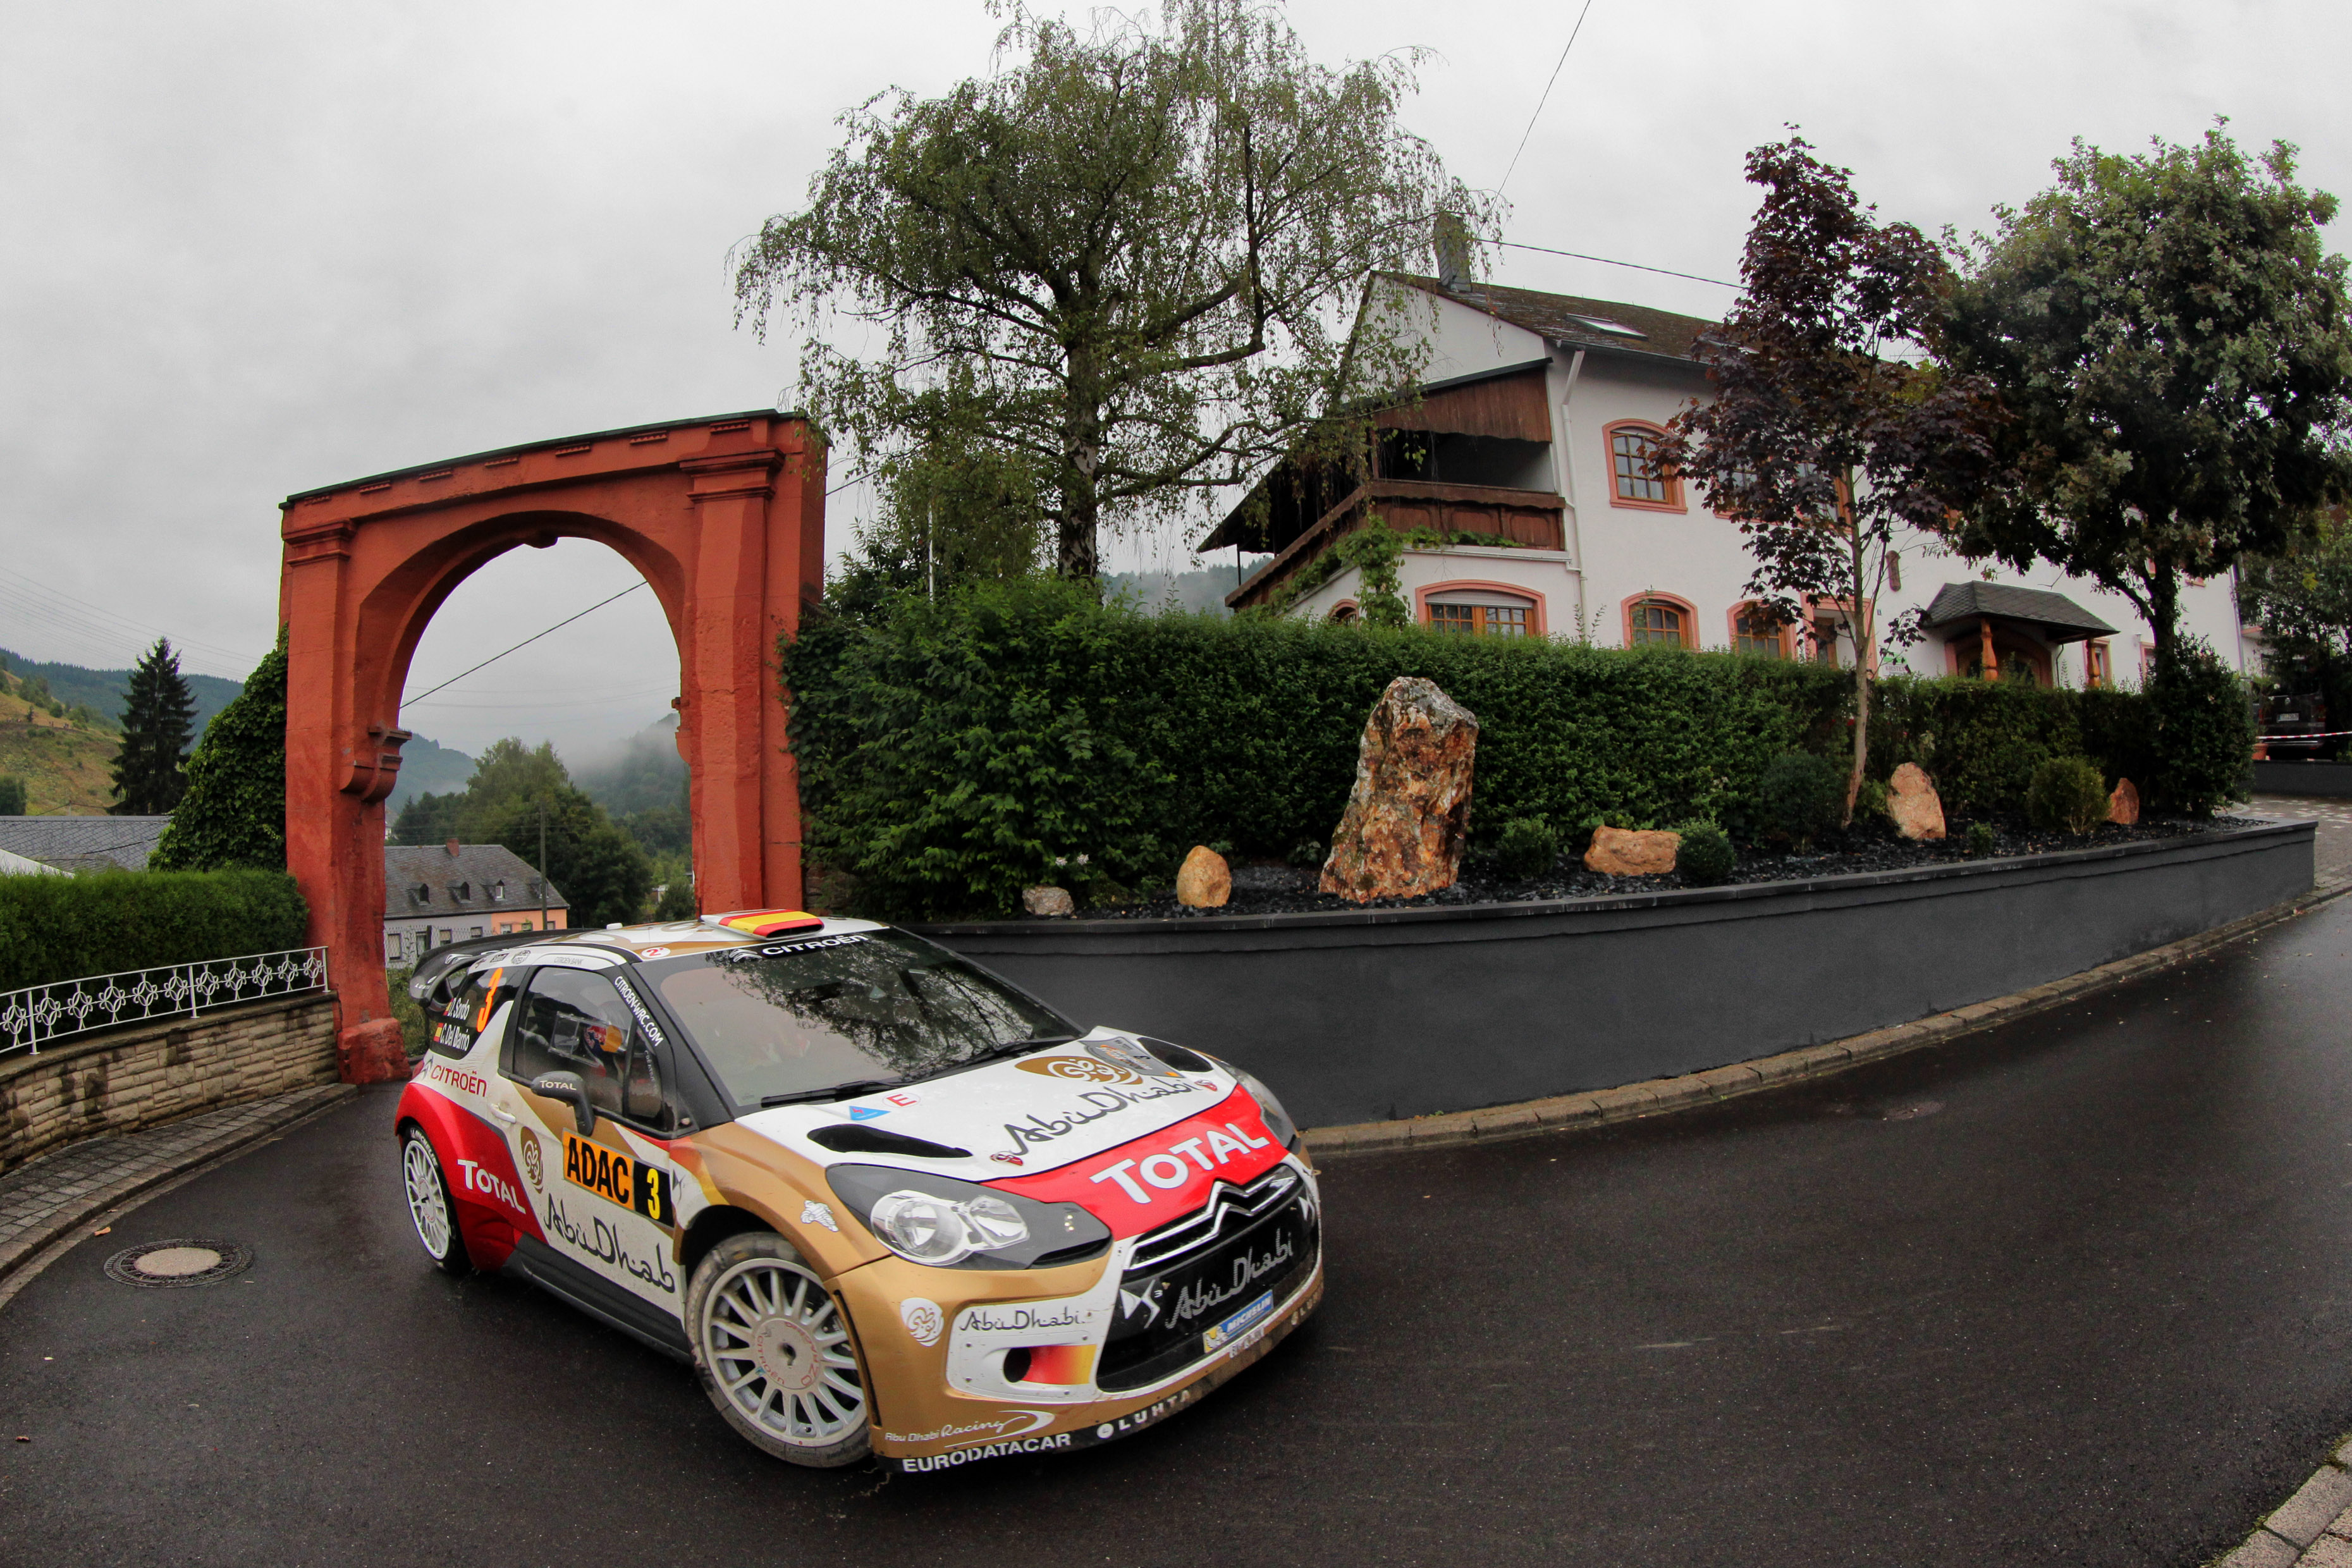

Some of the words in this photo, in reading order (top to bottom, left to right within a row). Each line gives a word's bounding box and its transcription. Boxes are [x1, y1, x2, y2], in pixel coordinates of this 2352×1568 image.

[453, 998, 470, 1020] Sordo
[477, 967, 503, 1032] 3
[614, 976, 664, 1047] CITROEN-WRC.COM
[444, 1024, 457, 1047] Del
[452, 1027, 470, 1051] Barrio
[539, 1080, 577, 1091] TOTAL
[886, 1094, 917, 1106] E
[567, 1137, 630, 1204] ADAC
[647, 1168, 661, 1220] 3
[1089, 1123, 1270, 1204] TOTAL
[457, 1160, 526, 1215] TOTAL
[1226, 1297, 1273, 1333] MICHELIN
[940, 1416, 1027, 1438] Racing
[1118, 1390, 1191, 1430] LUHTA
[902, 1433, 1072, 1473] EURODATACAR
